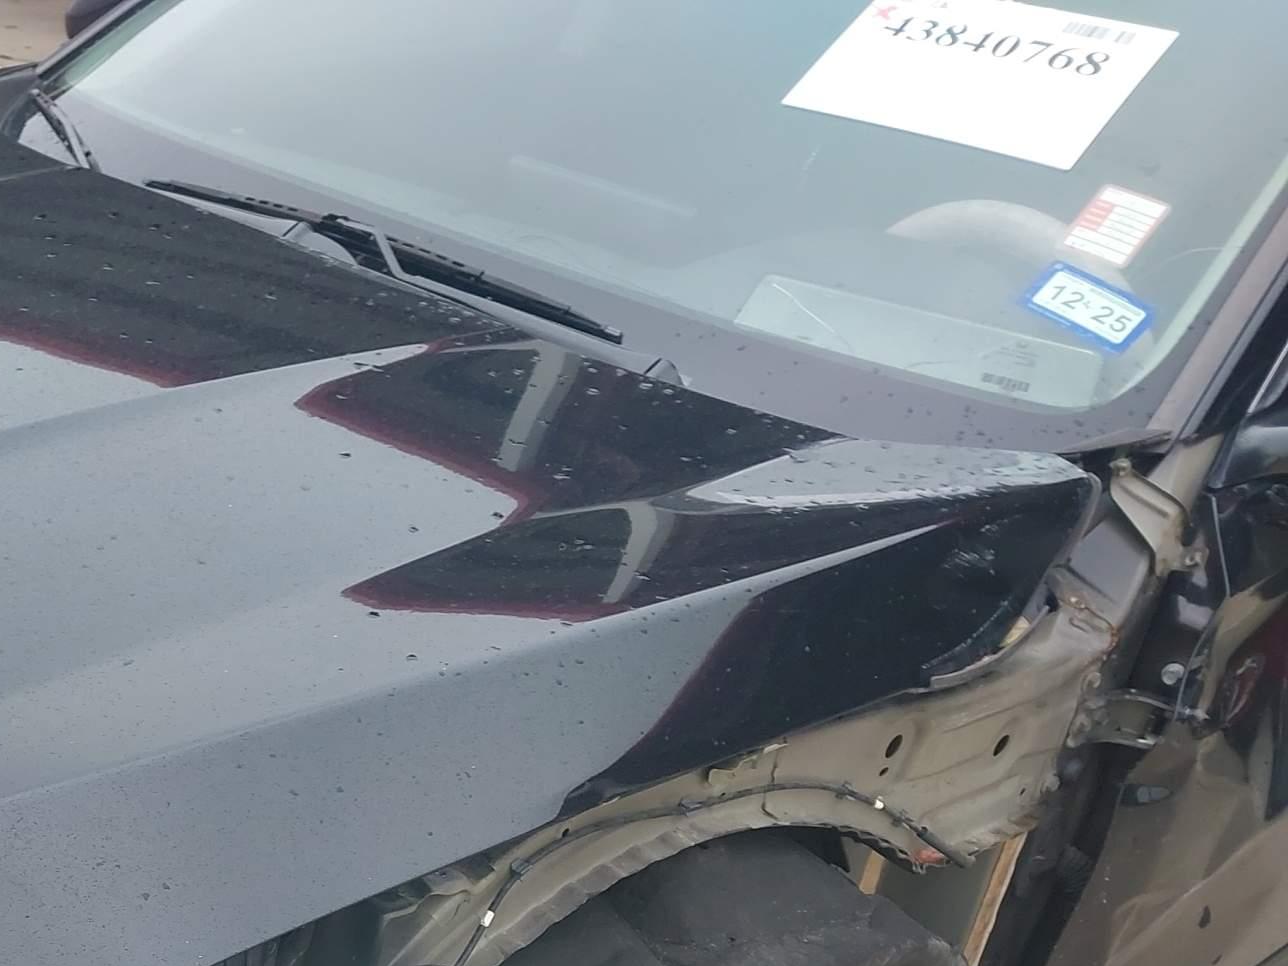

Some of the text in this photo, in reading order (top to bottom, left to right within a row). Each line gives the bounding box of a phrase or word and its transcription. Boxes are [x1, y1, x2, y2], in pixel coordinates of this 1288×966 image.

[882, 15, 1111, 78] 43840768
[1049, 284, 1086, 311] 12
[1089, 304, 1134, 335] 25
